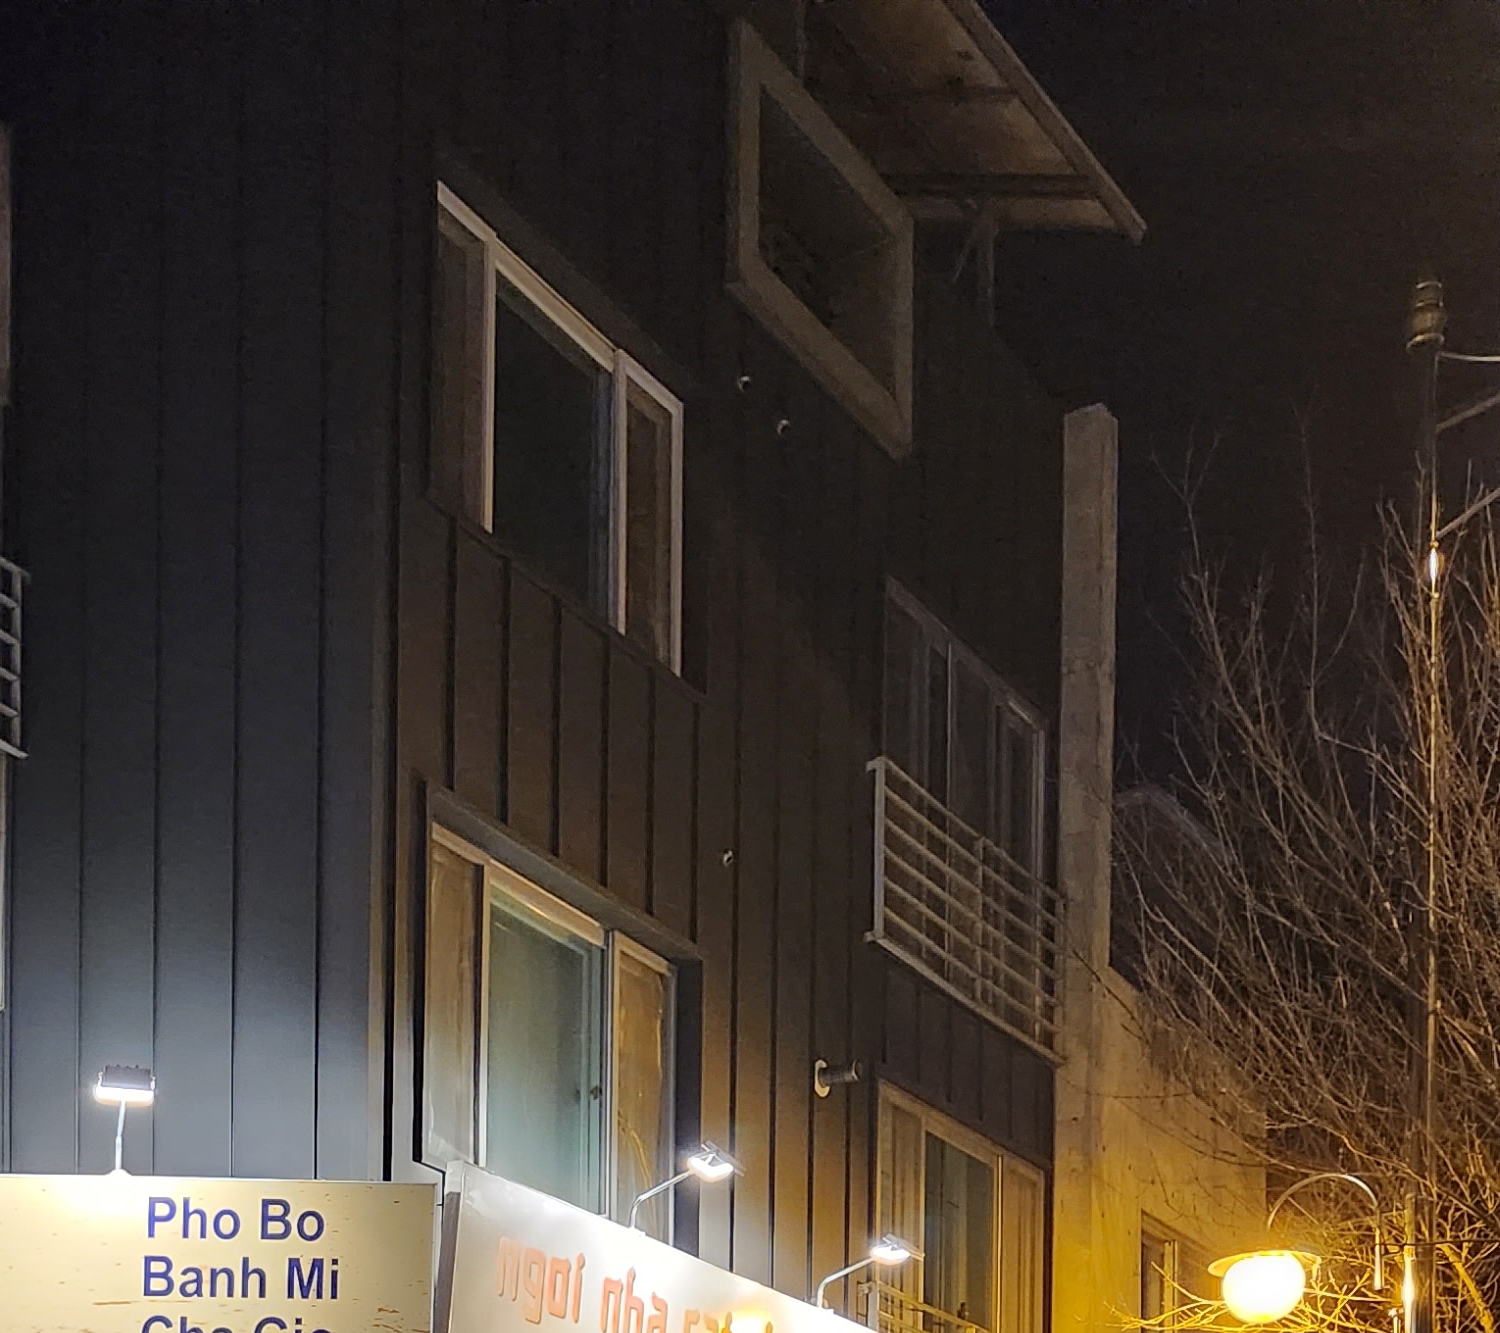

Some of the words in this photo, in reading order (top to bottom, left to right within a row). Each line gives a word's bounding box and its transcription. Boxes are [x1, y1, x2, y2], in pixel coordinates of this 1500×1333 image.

[147, 1196, 240, 1241] Pho
[261, 1198, 325, 1242] Bo
[143, 1256, 266, 1299] Banh
[286, 1257, 340, 1300] Mi
